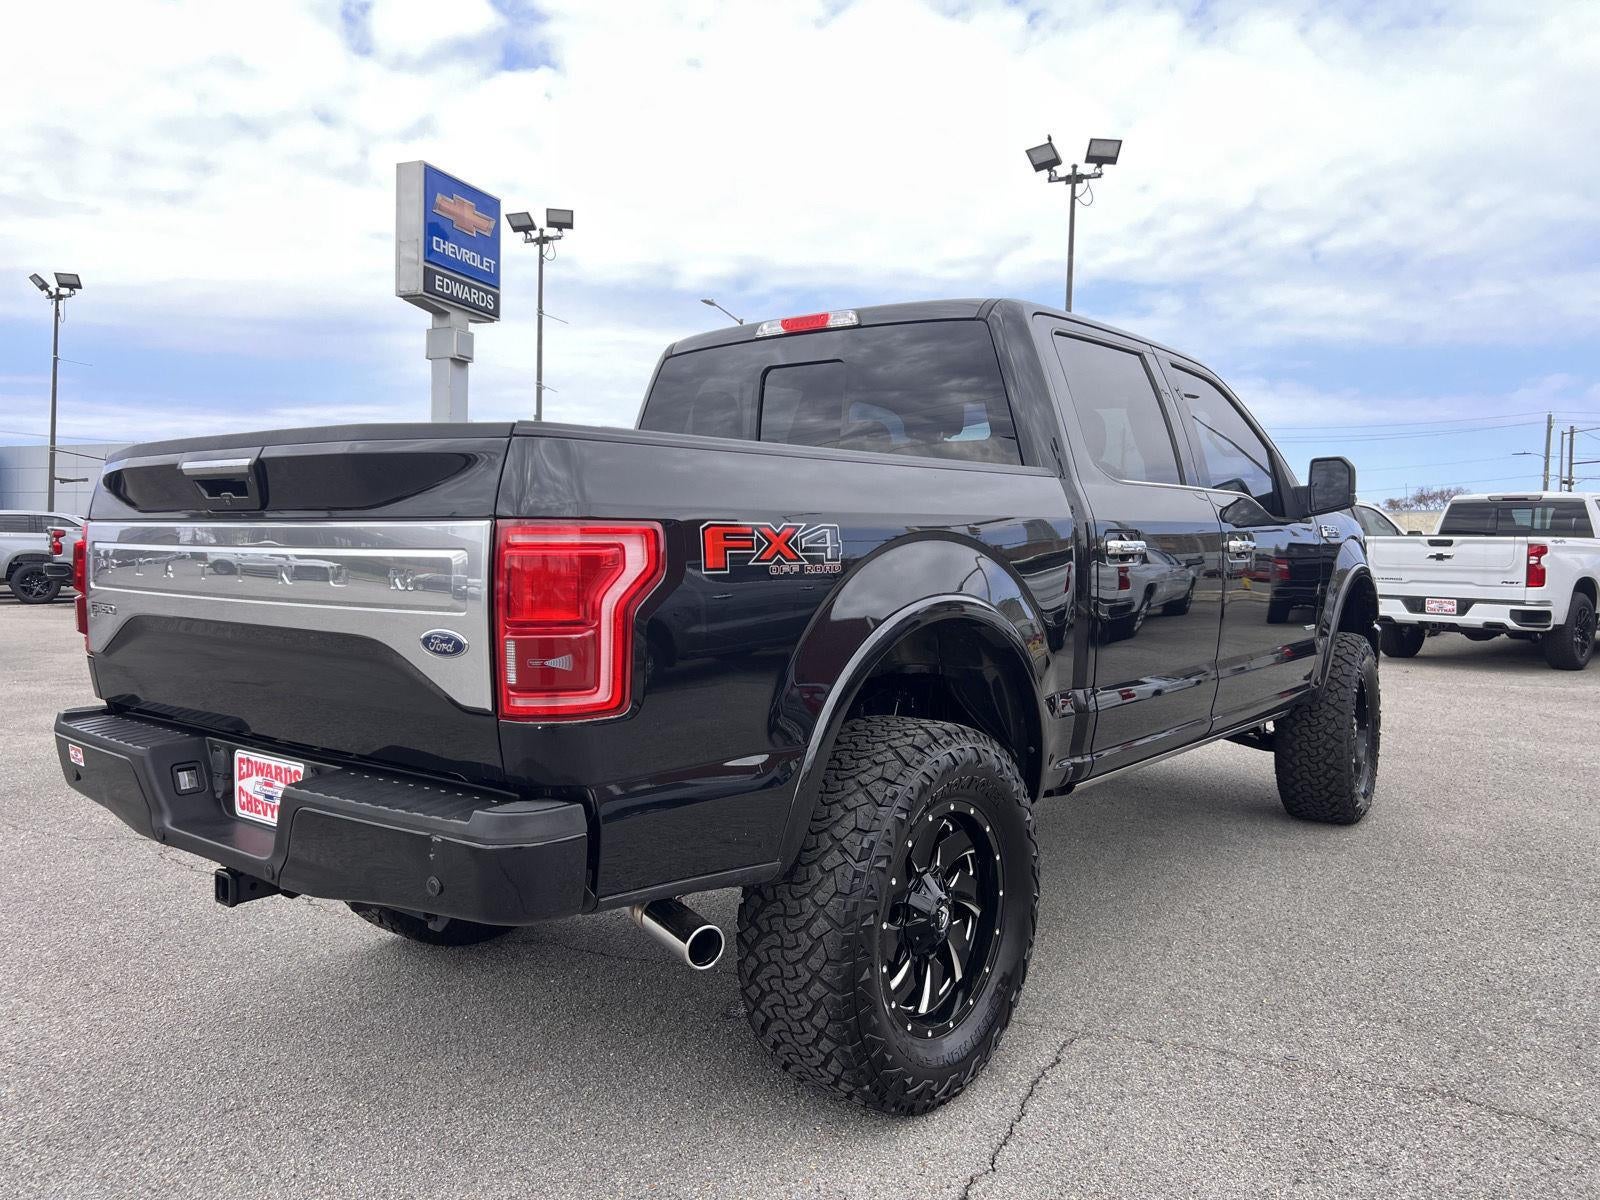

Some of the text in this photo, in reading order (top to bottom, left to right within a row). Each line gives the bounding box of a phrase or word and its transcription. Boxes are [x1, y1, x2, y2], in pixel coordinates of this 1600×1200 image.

[432, 236, 496, 274] CHEVROLET
[435, 274, 494, 310] EDWARDS
[700, 521, 843, 574] FX4
[769, 564, 842, 575] OFF ROAD
[428, 634, 455, 652] Ford
[237, 757, 302, 786] EDWARDS
